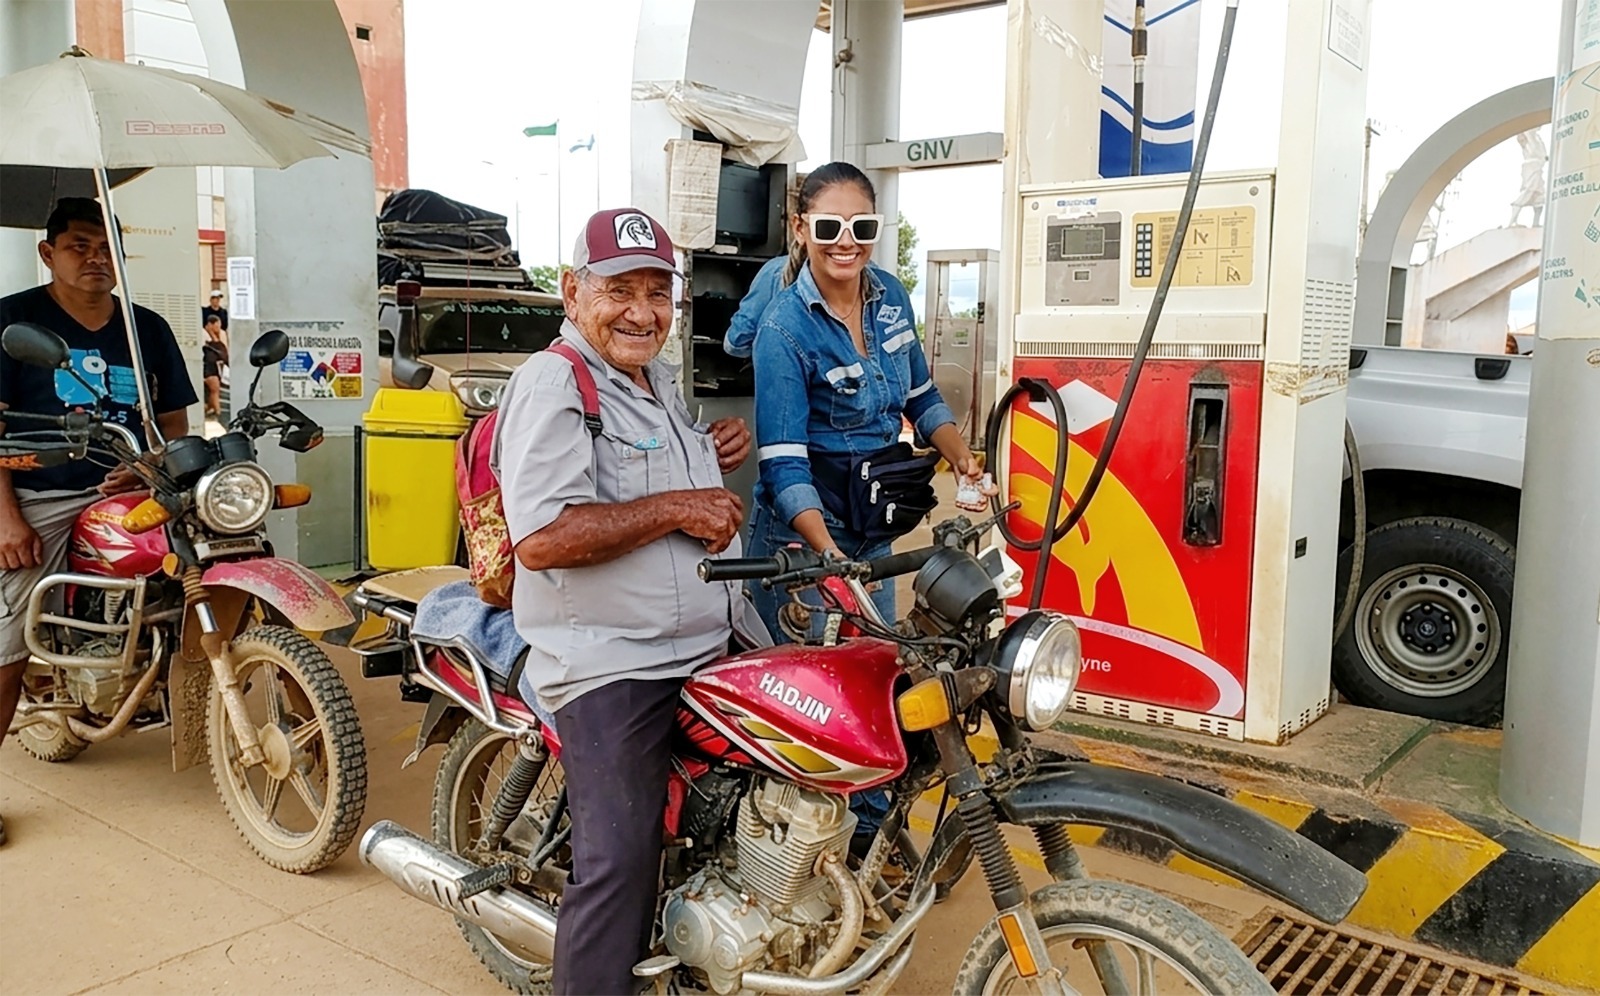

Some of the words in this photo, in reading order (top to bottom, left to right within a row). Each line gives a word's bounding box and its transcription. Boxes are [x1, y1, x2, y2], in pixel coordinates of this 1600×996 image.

[907, 138, 954, 162] GNV
[1080, 656, 1113, 673] yne
[758, 671, 833, 726] HADJIN
